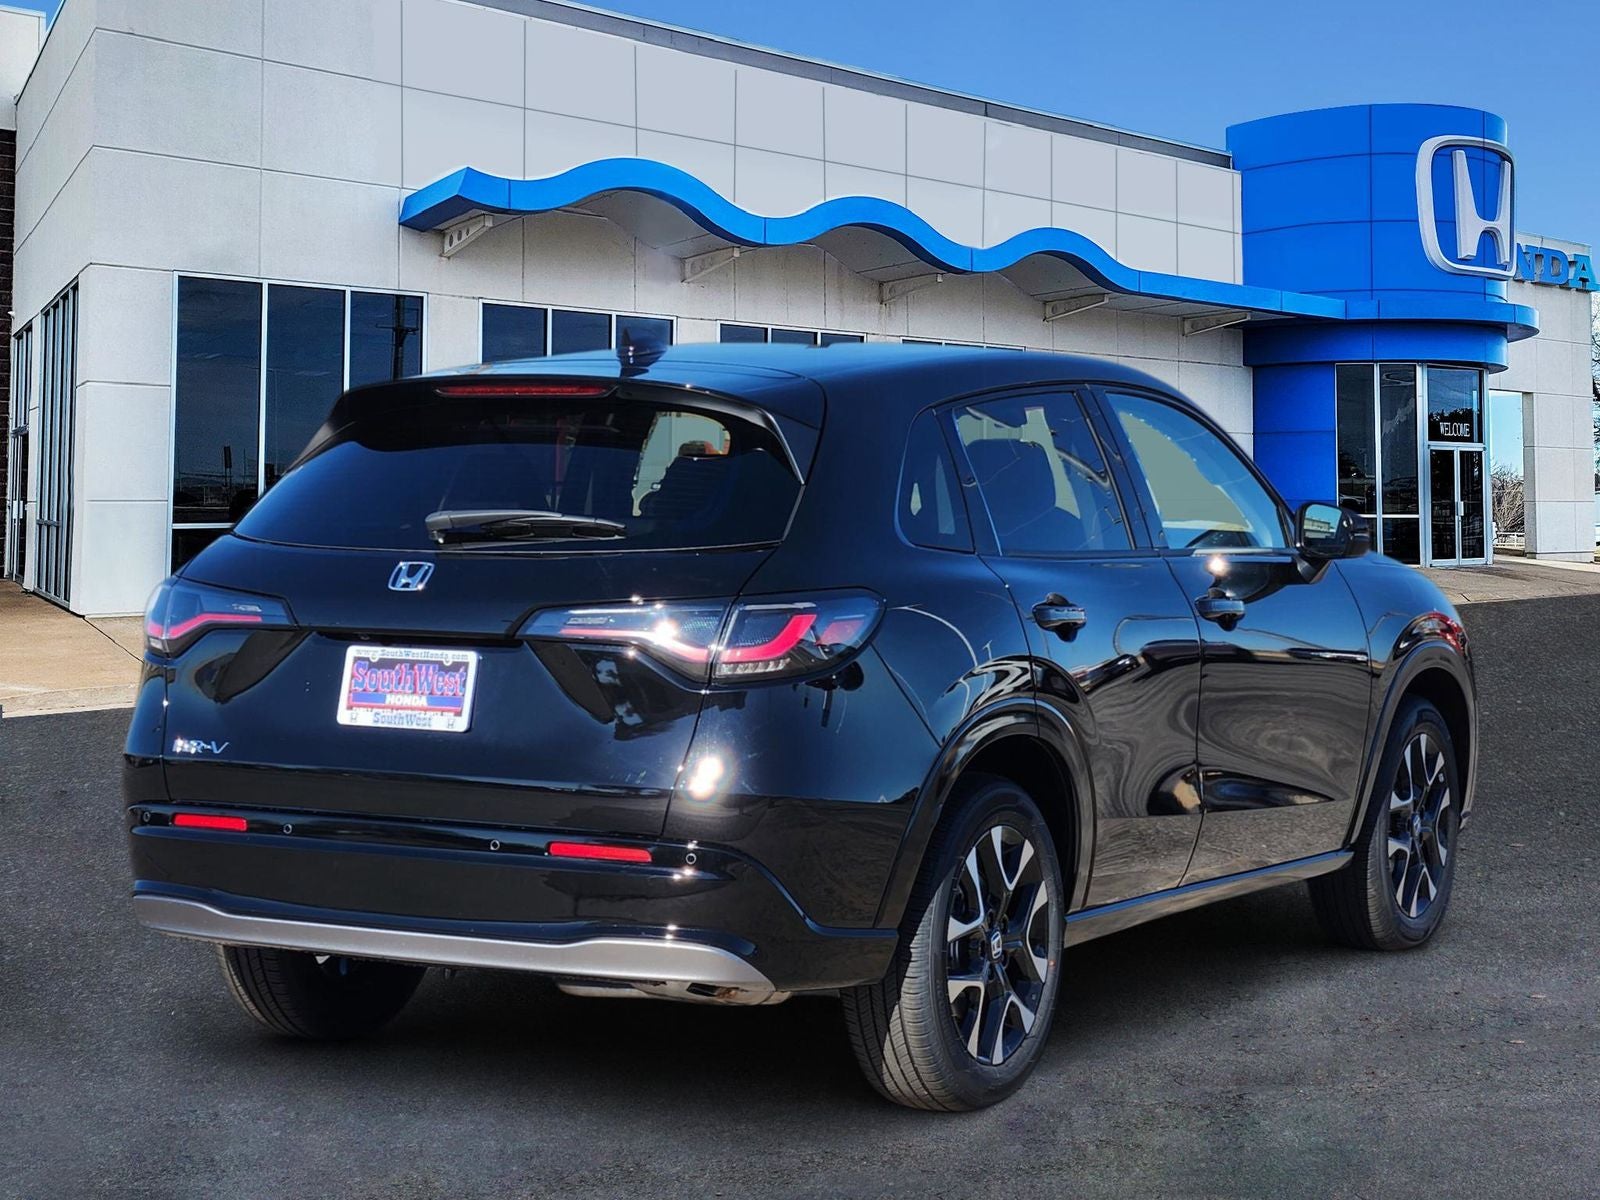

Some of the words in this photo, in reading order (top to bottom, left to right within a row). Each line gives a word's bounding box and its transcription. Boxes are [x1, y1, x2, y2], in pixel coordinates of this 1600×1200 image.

[1513, 242, 1600, 292] NDA
[1440, 422, 1471, 437] WELCOME
[385, 693, 428, 707] HONDA
